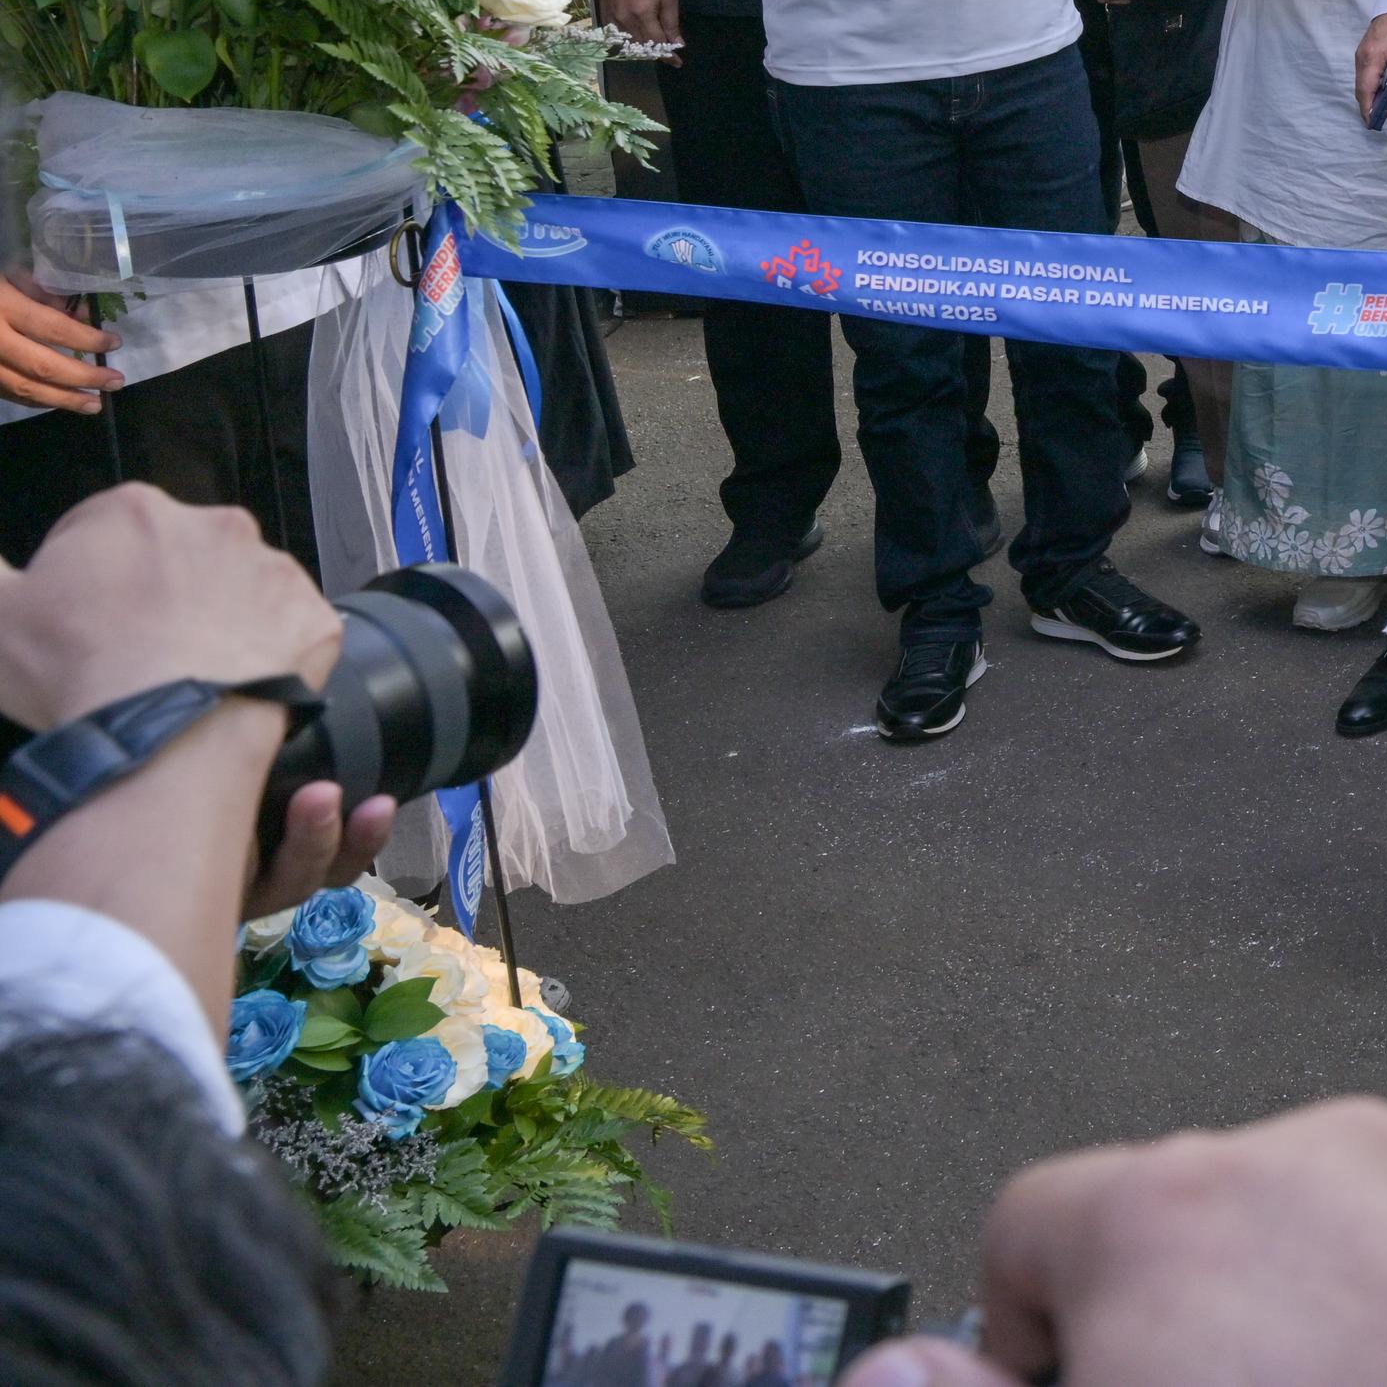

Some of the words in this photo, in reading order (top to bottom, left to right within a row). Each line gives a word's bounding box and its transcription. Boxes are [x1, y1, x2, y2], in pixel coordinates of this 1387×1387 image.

[857, 249, 1009, 275] KONSOLIDASI
[1015, 261, 1133, 283] NASIONAL
[855, 273, 995, 297] PENDIDIKAN
[1000, 283, 1079, 304] DASAR
[1085, 290, 1134, 307] DAN
[1139, 293, 1268, 315] MENENGAH
[857, 298, 936, 318] TAHUN
[940, 304, 998, 322] 2025
